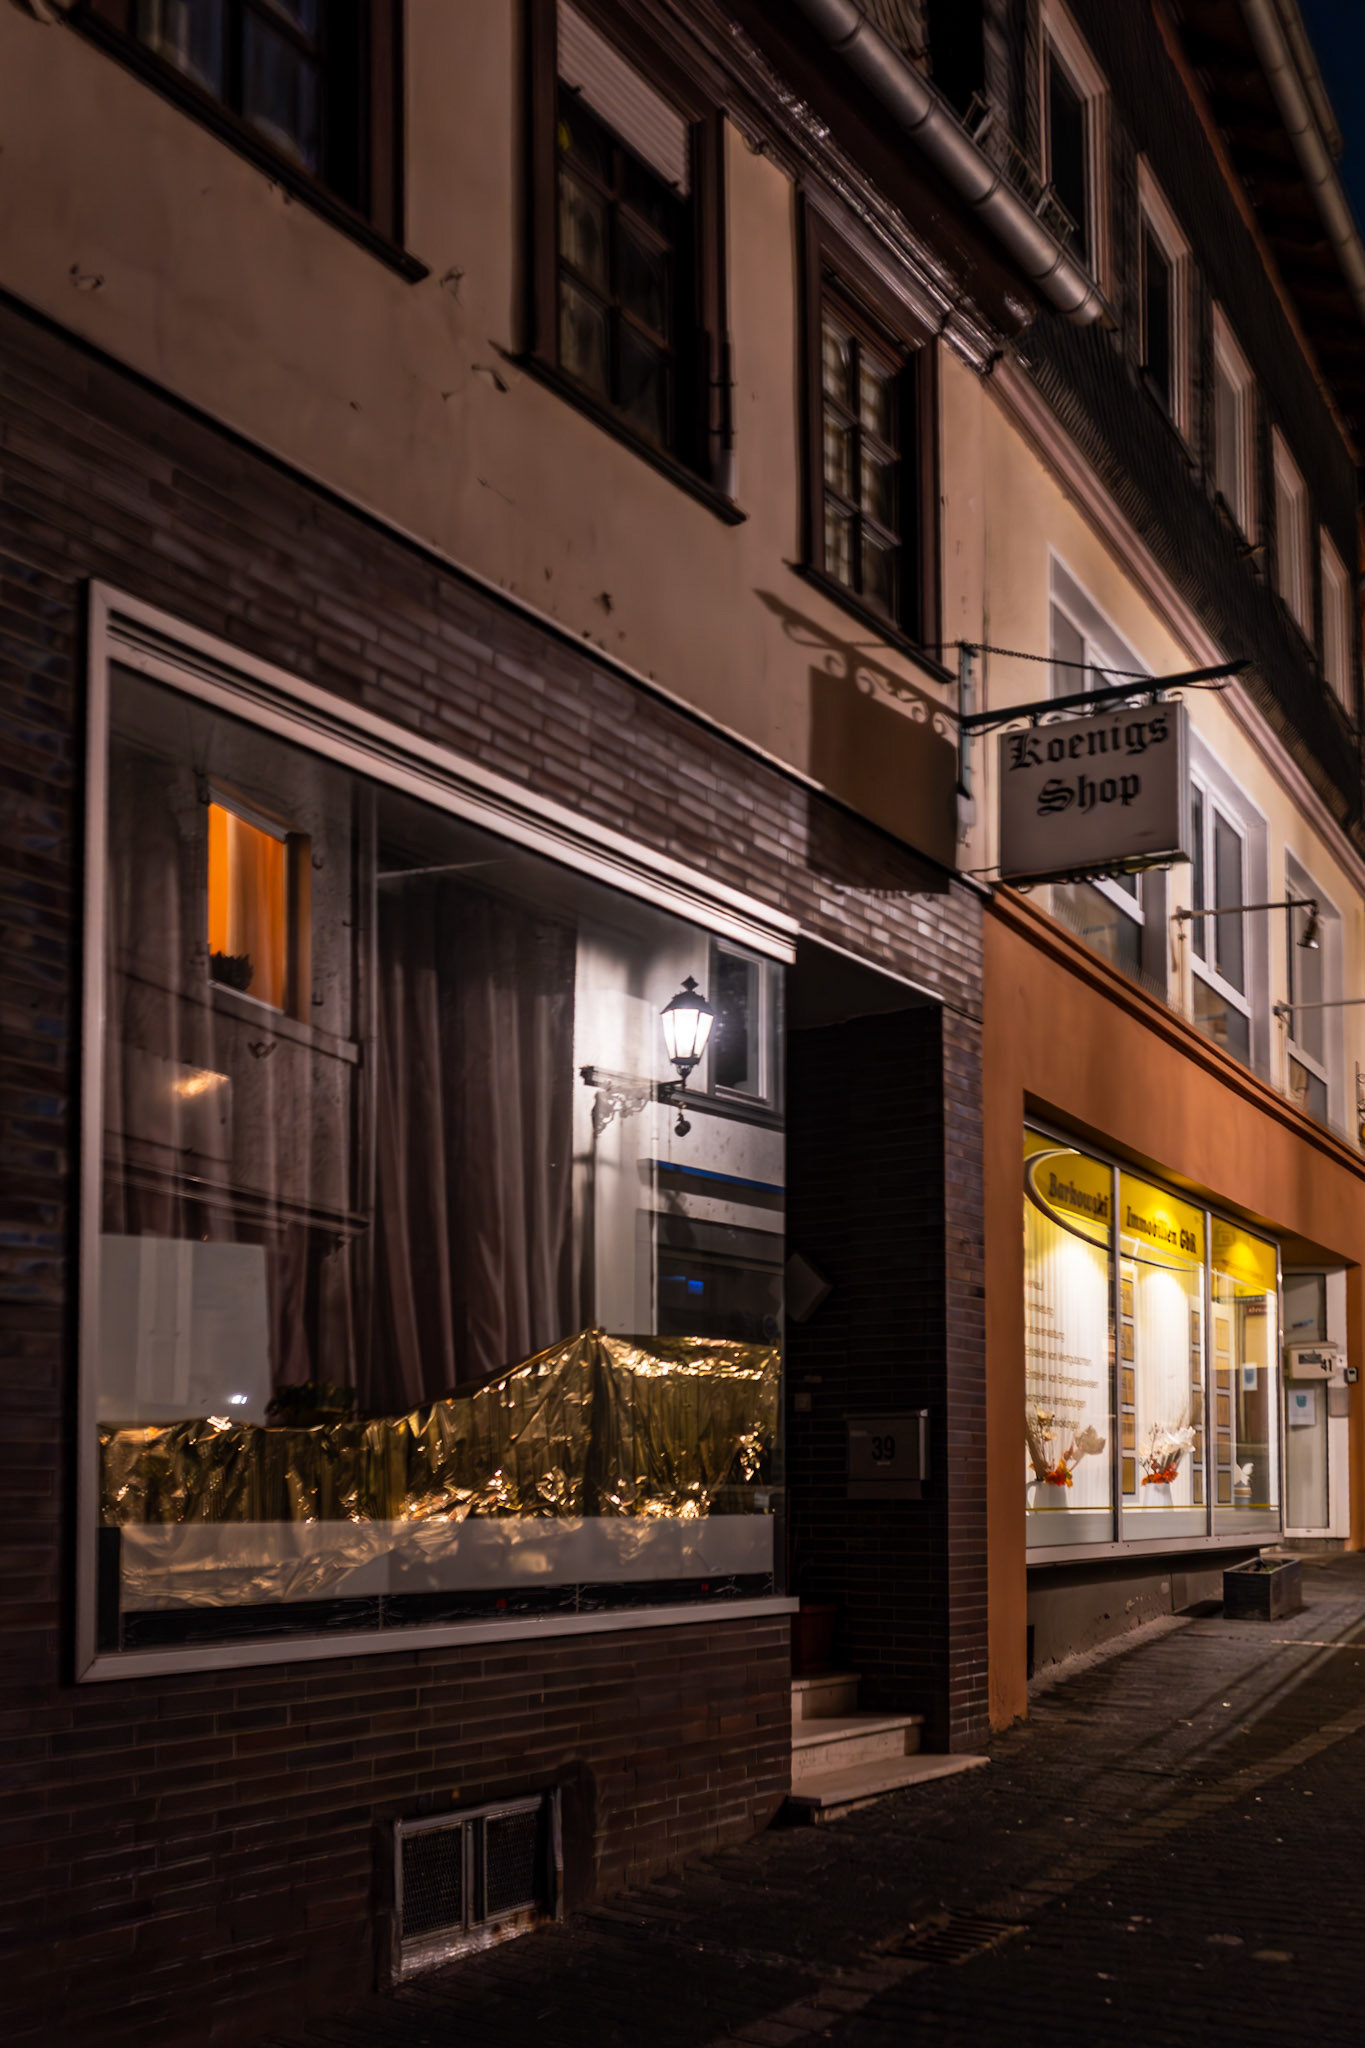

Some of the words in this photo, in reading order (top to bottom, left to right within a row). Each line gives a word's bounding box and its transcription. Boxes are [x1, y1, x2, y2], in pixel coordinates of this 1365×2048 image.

[1036, 773, 1141, 817] Shop
[1179, 1229, 1198, 1254] GbR
[1320, 1357, 1333, 1372] 41
[871, 1435, 896, 1461] 39
